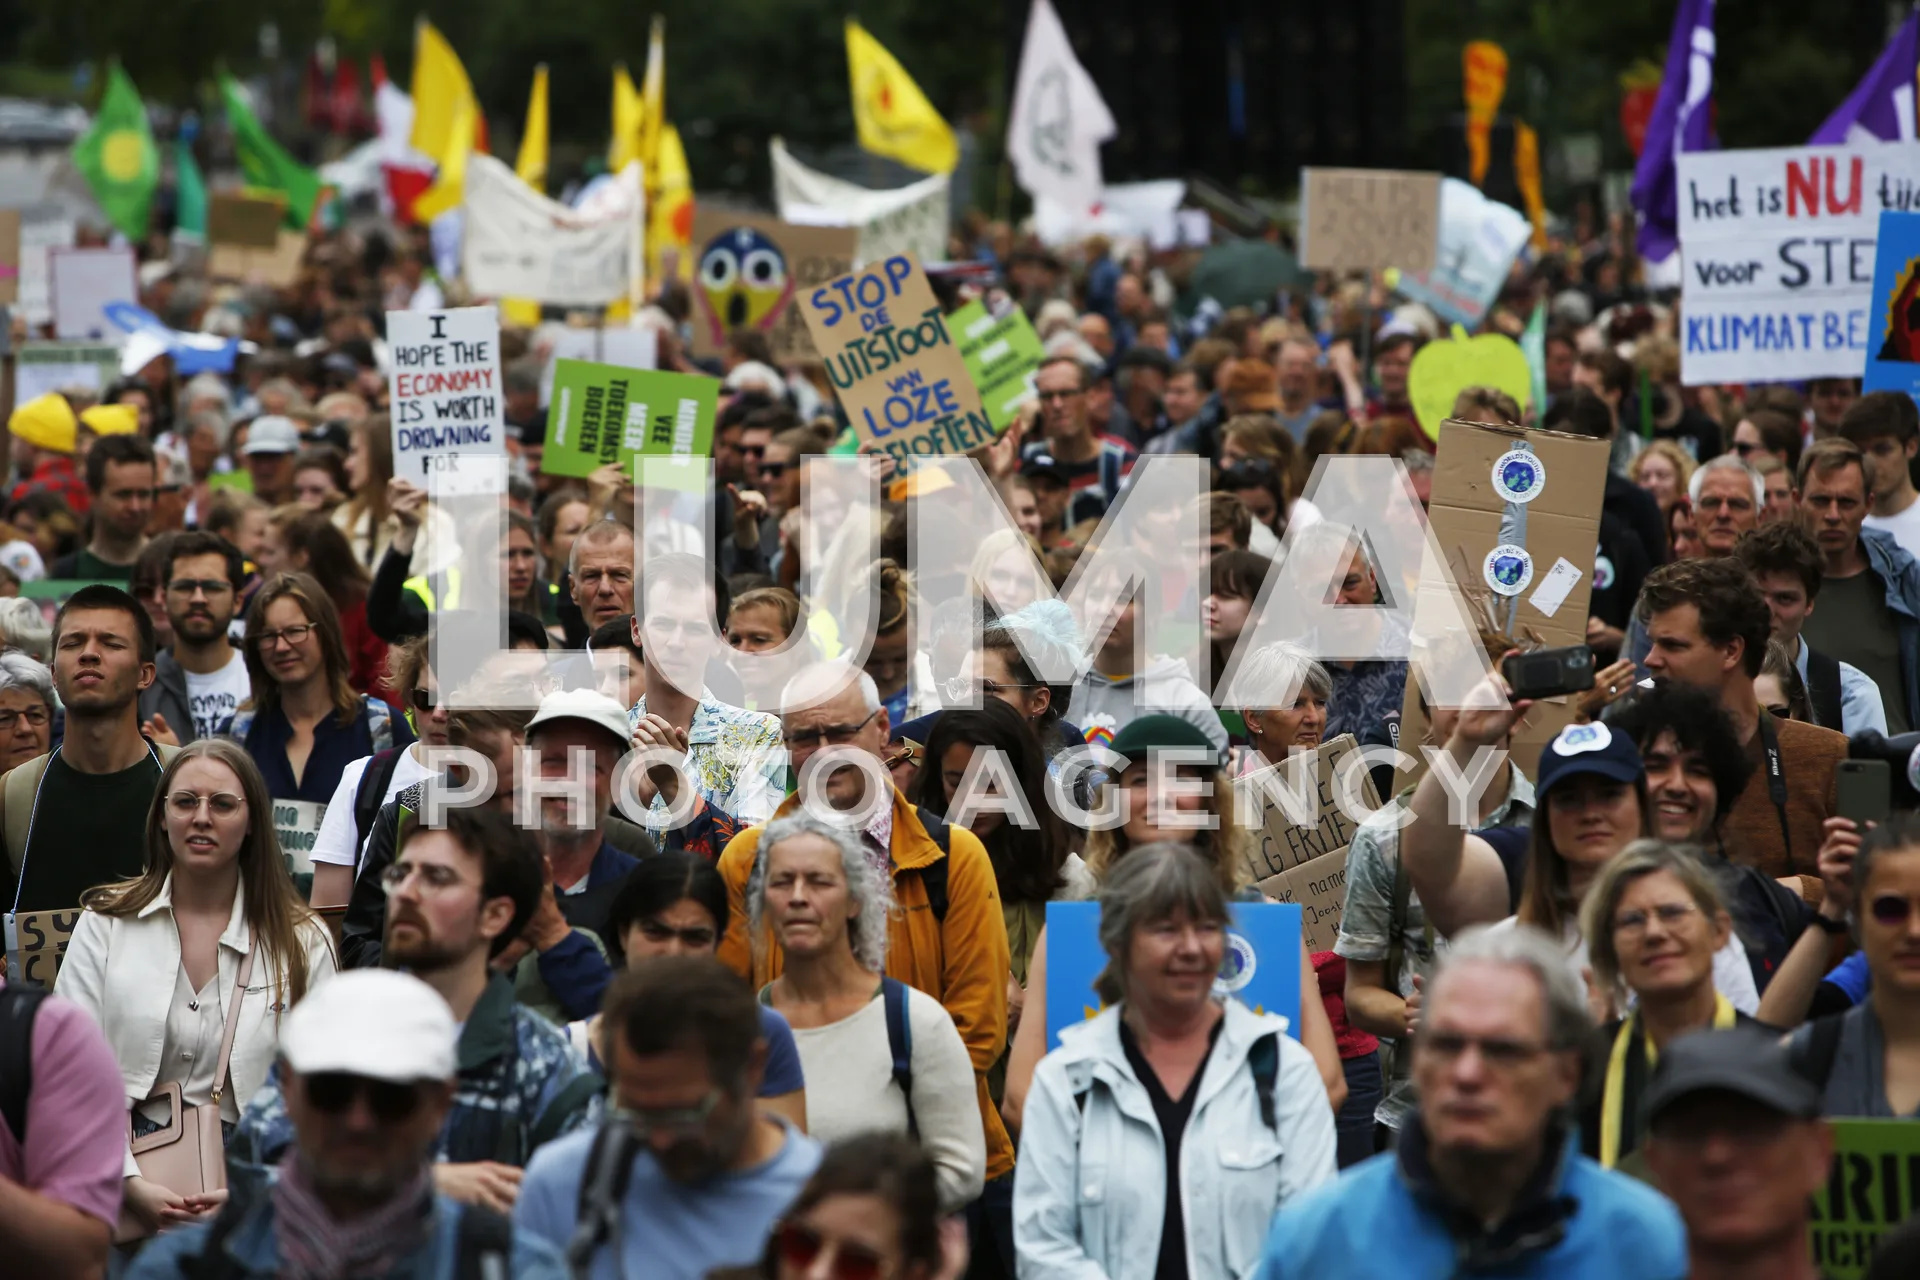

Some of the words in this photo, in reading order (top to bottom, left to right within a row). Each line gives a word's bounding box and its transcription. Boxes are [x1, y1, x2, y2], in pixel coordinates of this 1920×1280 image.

[1689, 175, 1742, 219] het
[1757, 186, 1782, 215] is
[1786, 155, 1863, 218] NU
[1695, 259, 1763, 287] voor
[1778, 237, 1877, 290] STE
[811, 256, 911, 327] STOP
[429, 315, 448, 338] I
[860, 306, 893, 332] DE
[1688, 309, 1867, 354] KLIMAATBE
[395, 344, 446, 367] HOPE
[449, 341, 489, 364] THE
[397, 369, 493, 397] ECONOMY
[885, 368, 923, 393] VAN
[398, 400, 424, 423] IS
[433, 396, 496, 421] WORTH
[578, 386, 605, 454] BOEREN
[863, 379, 960, 438] LOZE
[398, 424, 492, 452] DROWNING
[624, 401, 649, 451] MEER
[652, 415, 674, 445] VEE
[671, 398, 699, 467] MINDER
[421, 452, 460, 474] FOR
[1771, 756, 1780, 776] Nikon
[1246, 836, 1285, 882] EG
[1308, 868, 1346, 897] name
[1307, 900, 1343, 924] Joost
[23, 912, 80, 952] SY
